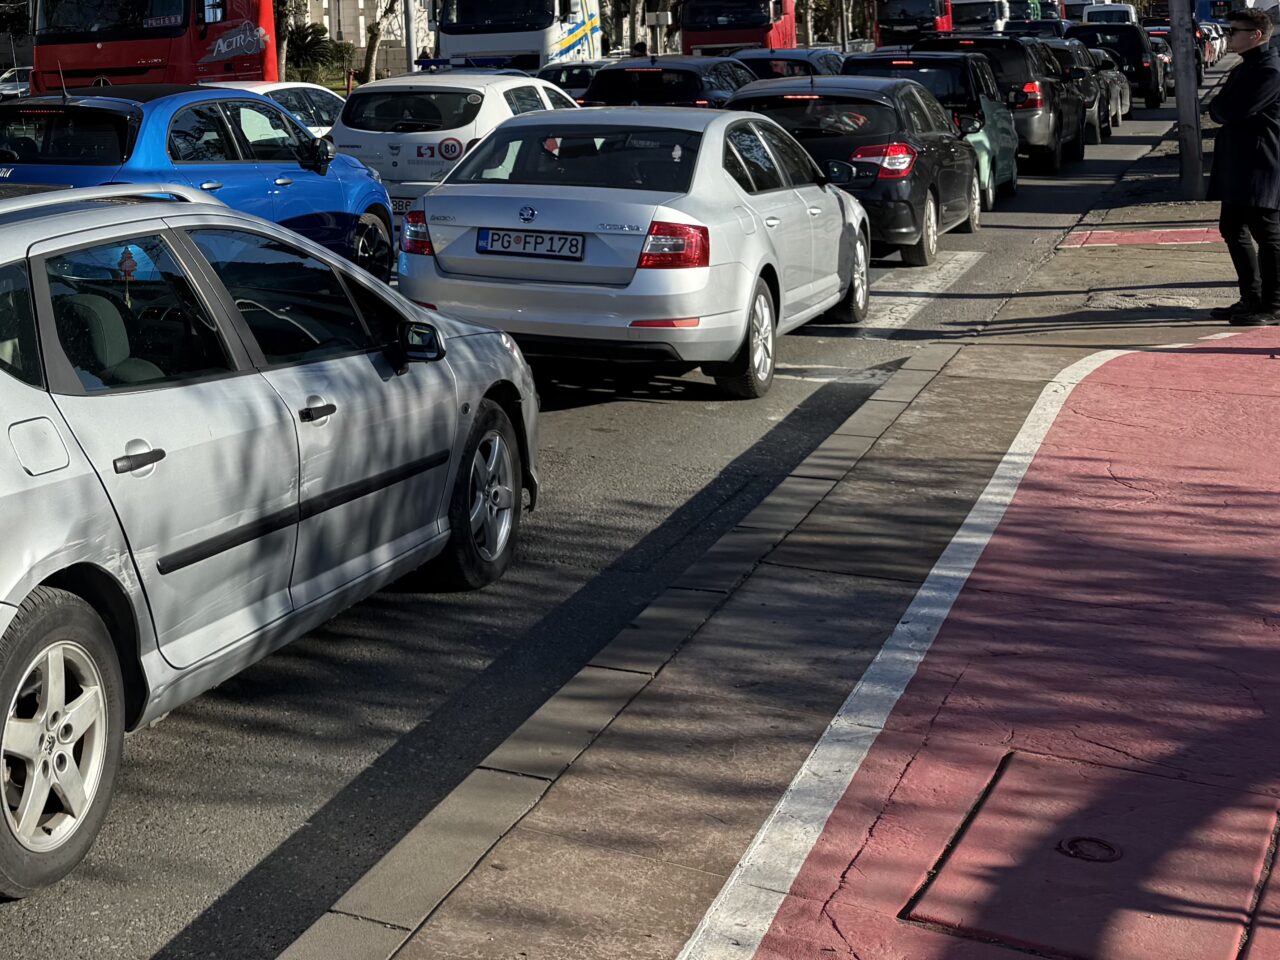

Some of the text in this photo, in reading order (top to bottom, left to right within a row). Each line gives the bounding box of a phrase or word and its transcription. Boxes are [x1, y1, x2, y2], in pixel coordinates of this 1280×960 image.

[444, 144, 456, 154] 80
[490, 232, 512, 249] PG
[522, 234, 579, 254] FP178
